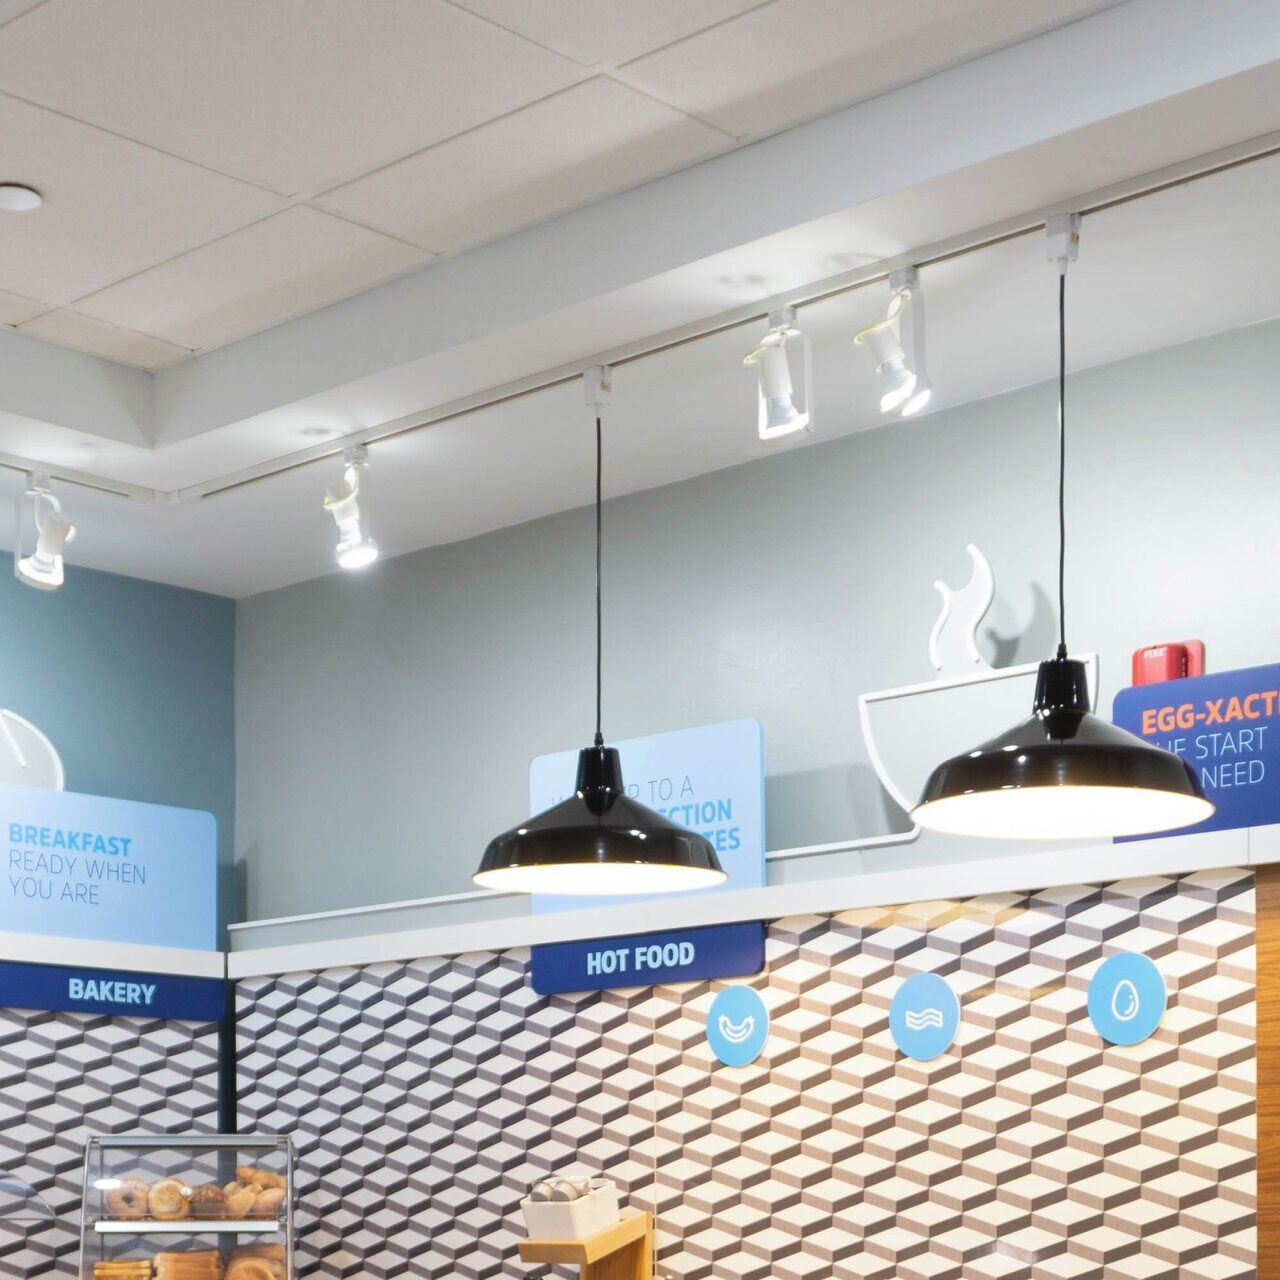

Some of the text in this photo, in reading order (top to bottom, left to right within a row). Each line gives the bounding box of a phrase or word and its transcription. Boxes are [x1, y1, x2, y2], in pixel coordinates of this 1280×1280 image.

[1196, 726, 1268, 759] START
[647, 779, 672, 803] TO
[680, 775, 695, 798] A
[1201, 760, 1265, 788] NEED
[9, 823, 132, 857] BREAKFAST
[9, 849, 147, 885] READY WHEN
[9, 875, 100, 905] YOU ARE
[587, 942, 695, 975] HOT FOOD
[68, 978, 156, 1005] BAKERY
